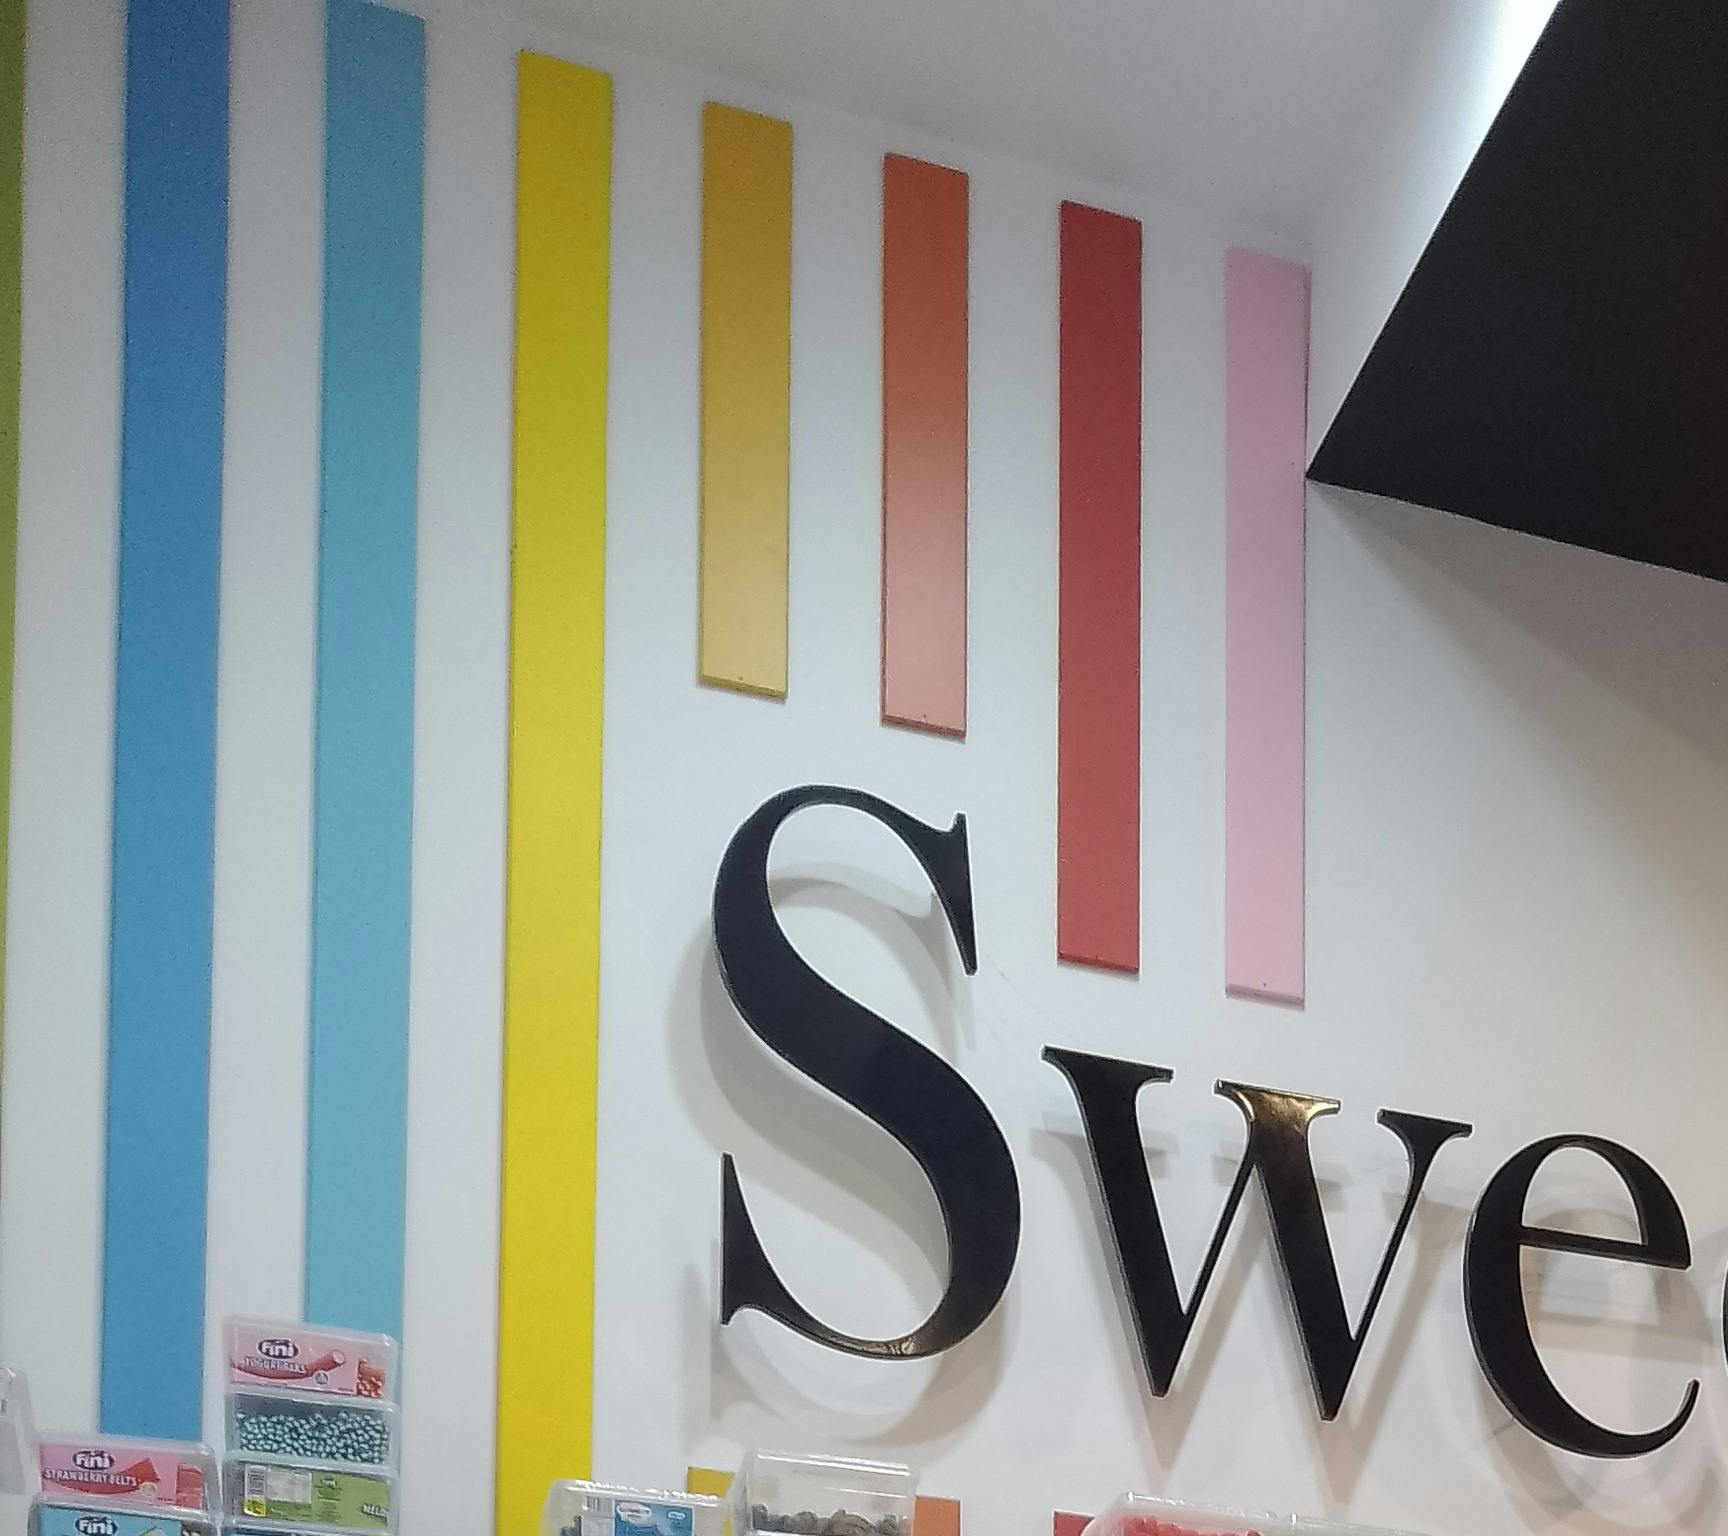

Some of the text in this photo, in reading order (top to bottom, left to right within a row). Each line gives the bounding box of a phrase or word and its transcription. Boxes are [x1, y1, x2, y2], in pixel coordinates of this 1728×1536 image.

[262, 1340, 295, 1357] Fini
[76, 1452, 111, 1470] Fini
[44, 1470, 138, 1487] STRAWBERRY BELTS
[78, 1519, 114, 1536] Fini
